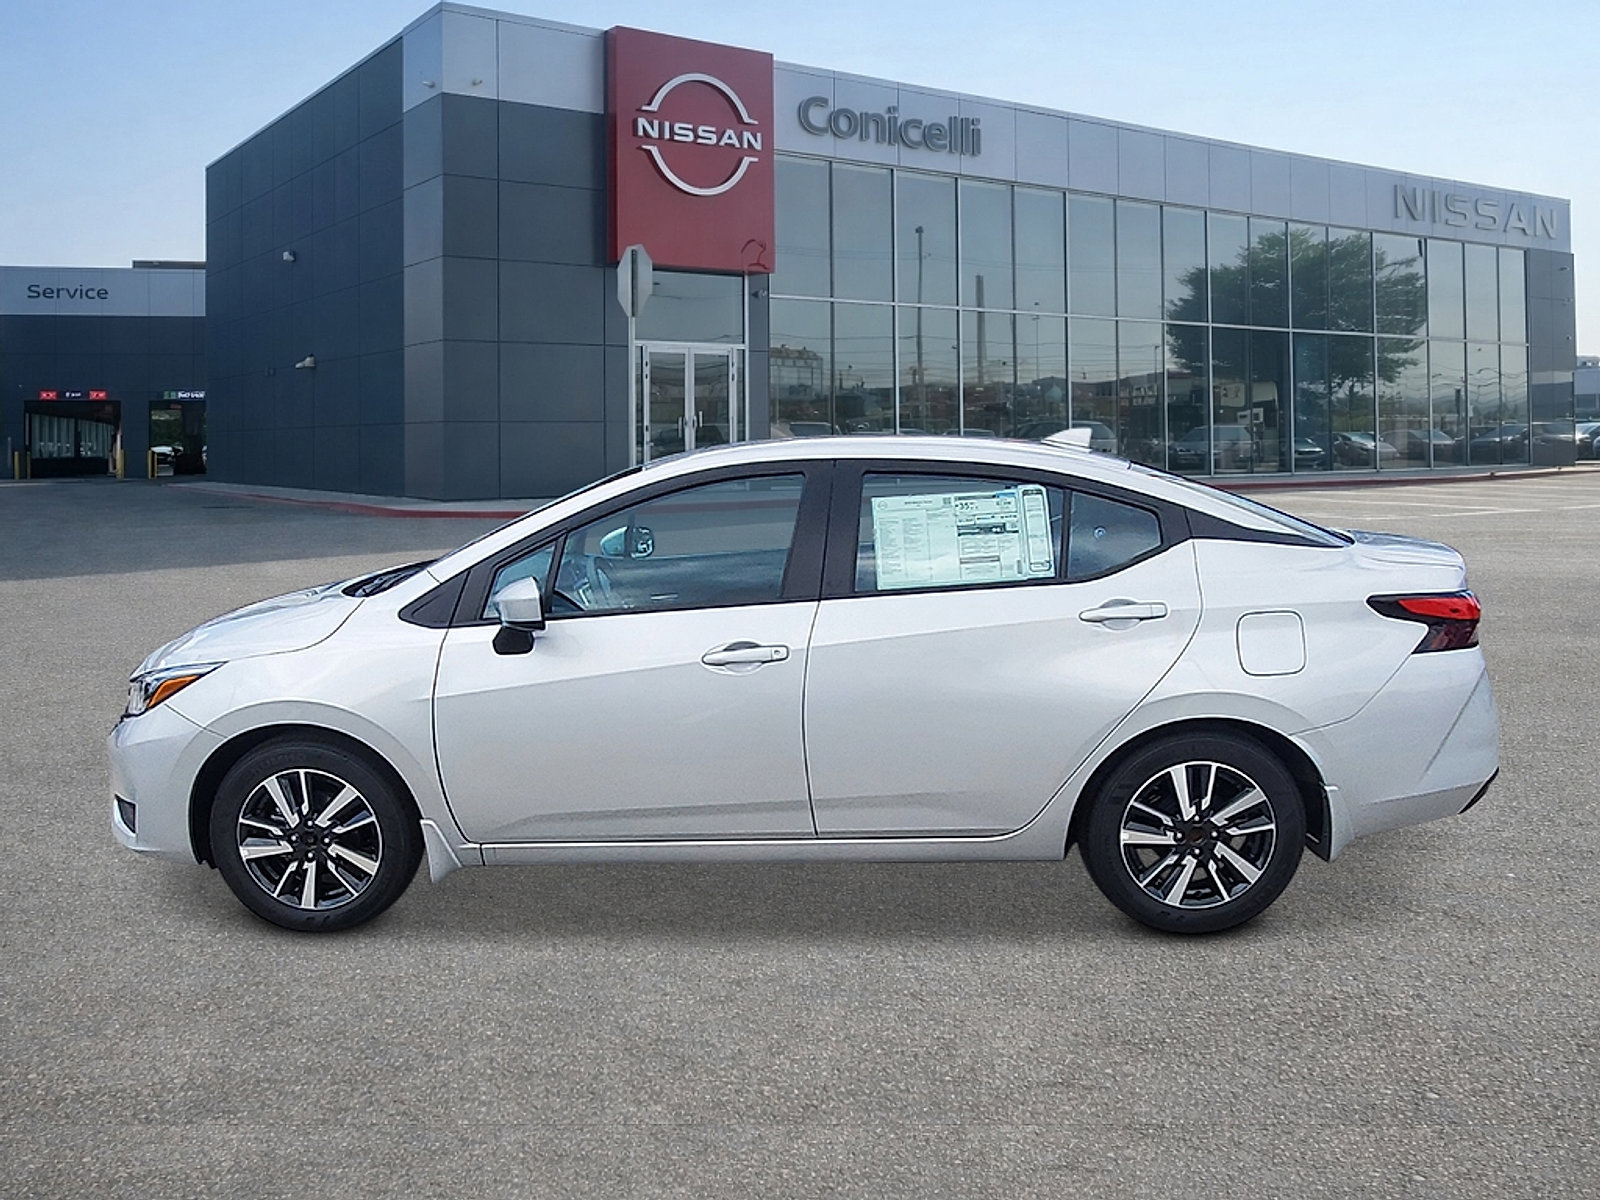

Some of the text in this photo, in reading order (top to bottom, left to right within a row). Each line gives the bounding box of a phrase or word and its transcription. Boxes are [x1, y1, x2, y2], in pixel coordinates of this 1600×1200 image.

[635, 116, 763, 151] NISSAN
[798, 95, 982, 156] Conicelli
[1394, 184, 1557, 239] NISSAN
[27, 284, 108, 300] Service
